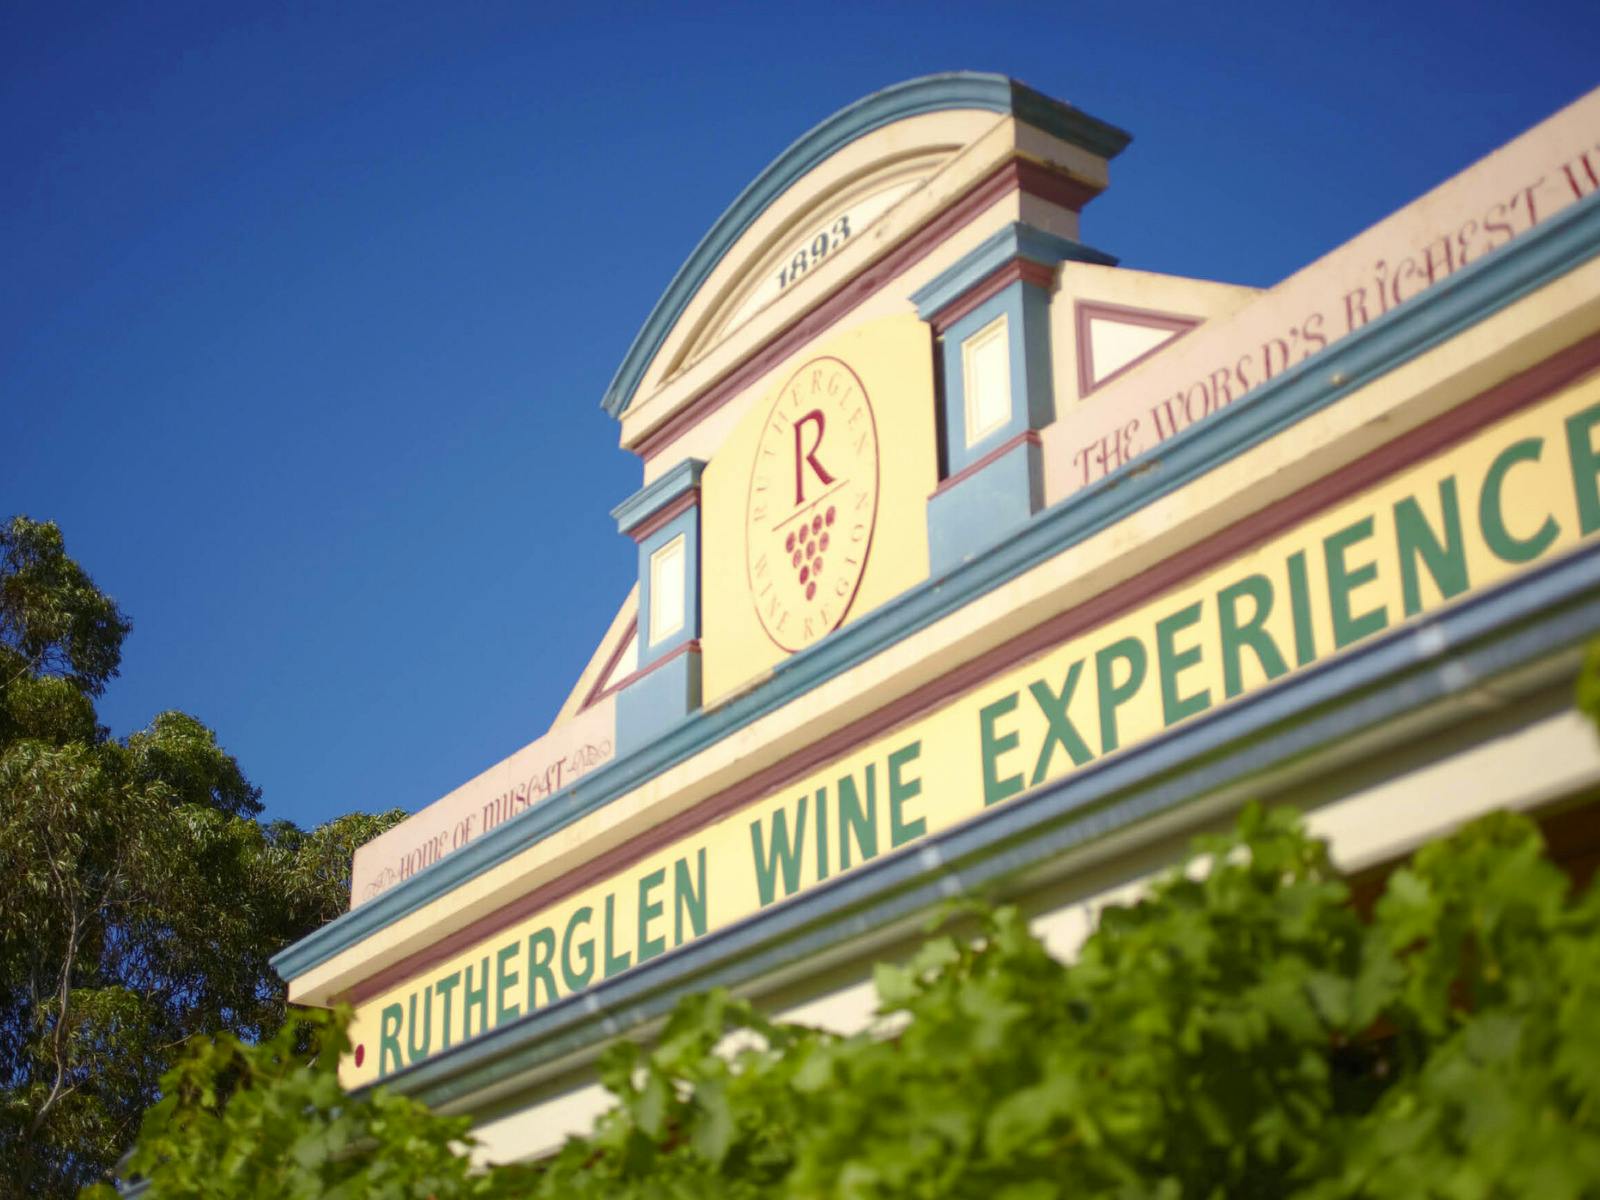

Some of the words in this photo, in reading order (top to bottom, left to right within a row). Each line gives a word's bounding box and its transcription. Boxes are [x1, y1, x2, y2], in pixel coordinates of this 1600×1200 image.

[776, 215, 851, 289] 1893
[1073, 418, 1140, 485] THE
[1343, 176, 1546, 332] RICHEST
[753, 368, 868, 522] RUTHERGLEN
[793, 408, 837, 506] R
[755, 552, 788, 633] WINE
[379, 846, 708, 1080] RUTHERGLEN
[750, 740, 927, 908] WINE
[979, 402, 1600, 808] EXPERIENCE
[400, 831, 449, 882] HOME
[452, 813, 477, 852] OF
[482, 756, 567, 833] MUSCAT
